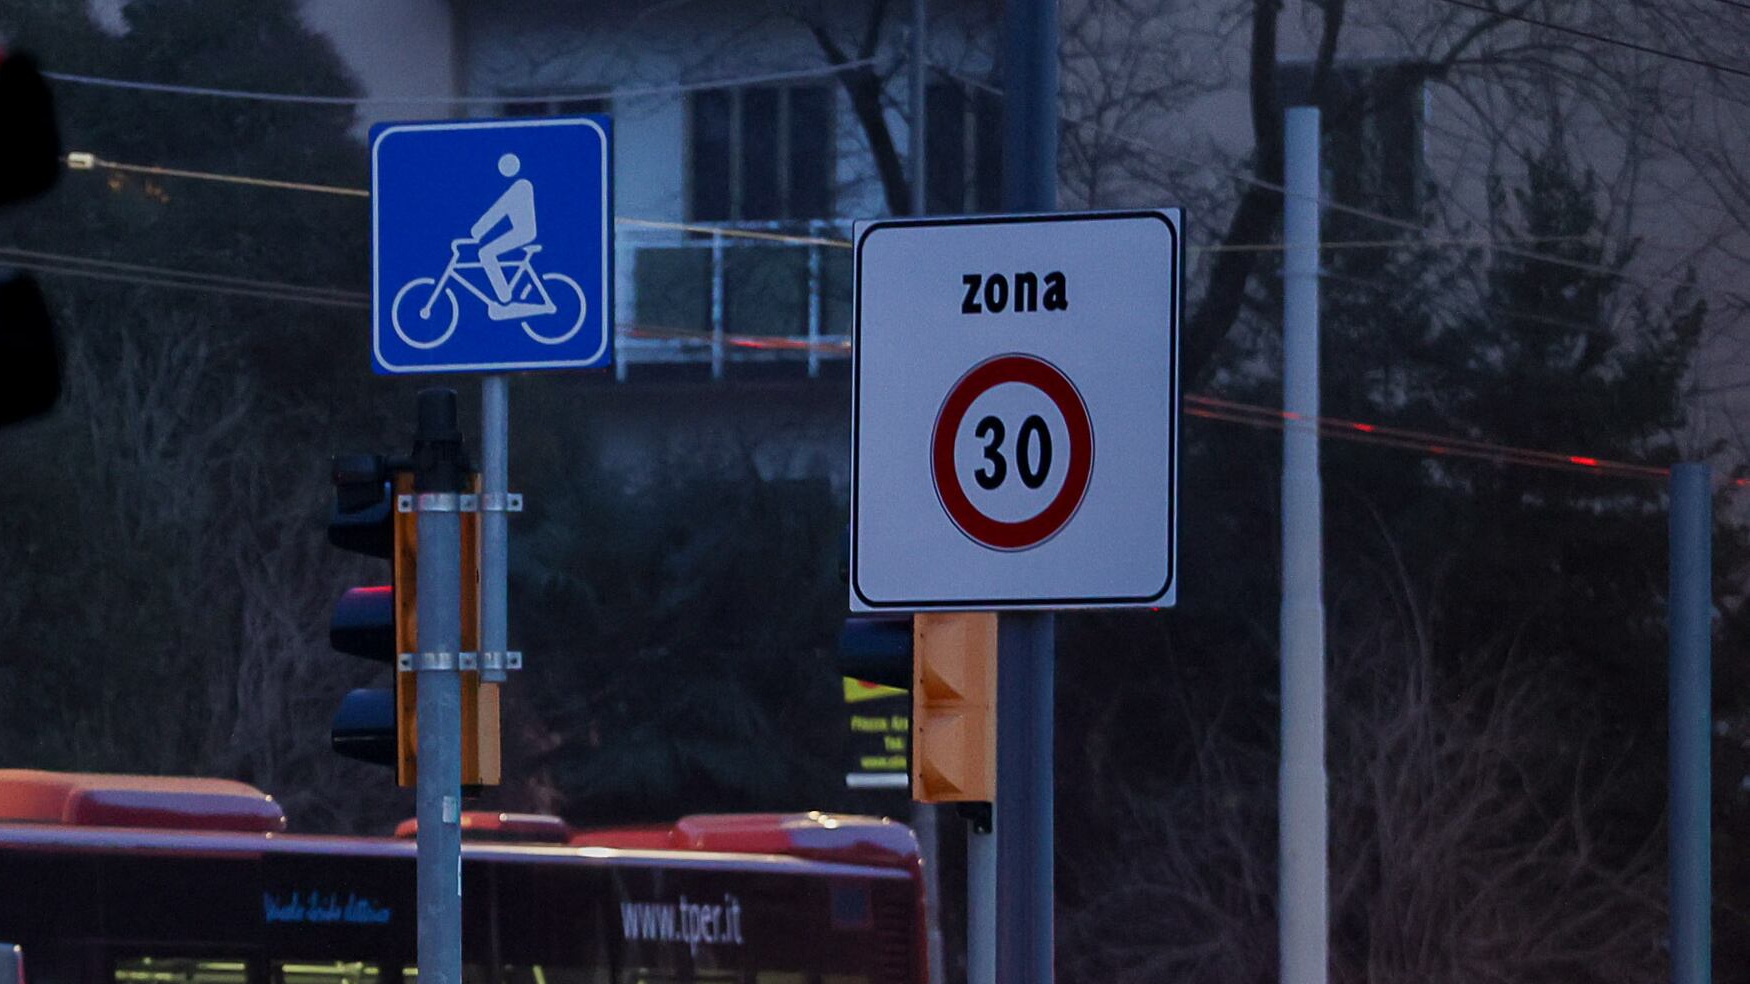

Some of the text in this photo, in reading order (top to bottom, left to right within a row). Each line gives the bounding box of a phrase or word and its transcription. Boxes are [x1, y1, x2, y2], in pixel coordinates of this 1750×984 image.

[961, 269, 1068, 315] zona
[973, 413, 1053, 492] 30
[619, 892, 746, 958] www.tper.it
